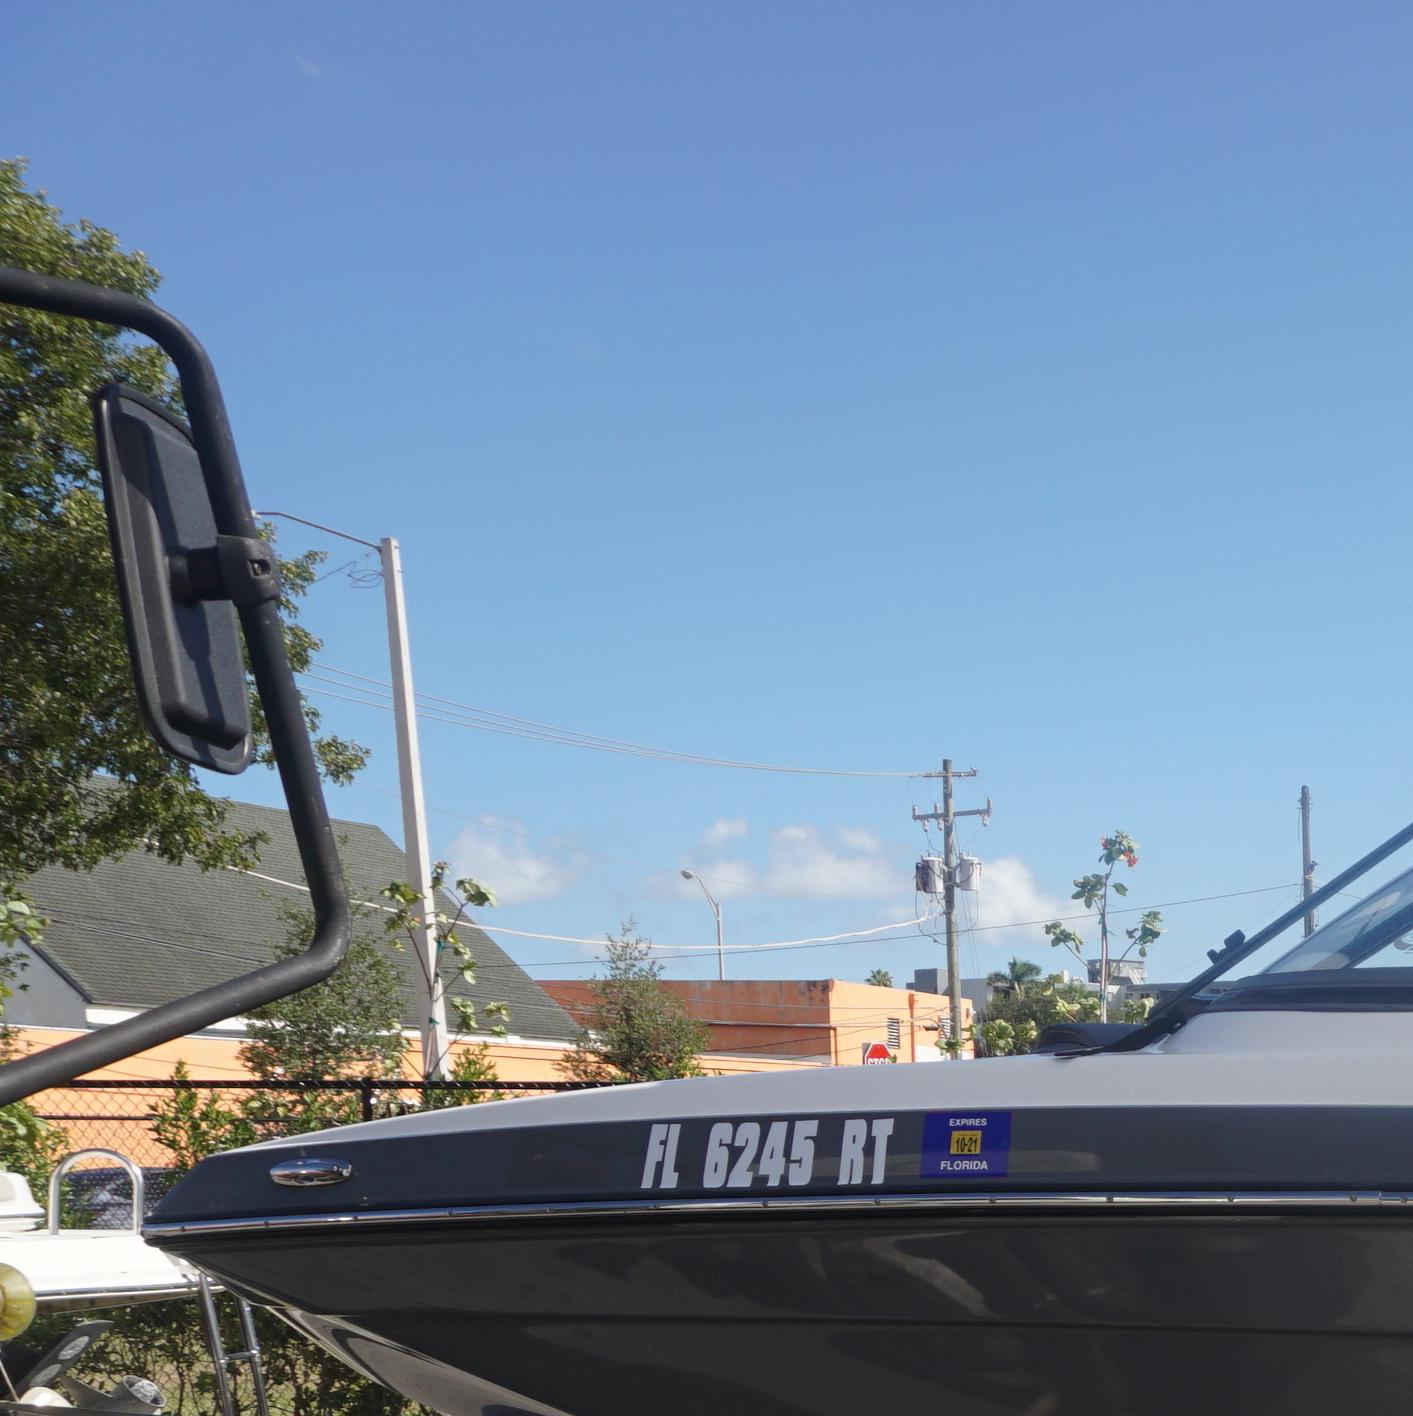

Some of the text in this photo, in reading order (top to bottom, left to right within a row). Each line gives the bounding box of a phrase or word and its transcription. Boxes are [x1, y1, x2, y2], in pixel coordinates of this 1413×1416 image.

[948, 1118, 988, 1127] EXPIRES
[955, 1136, 978, 1153] 10-21
[640, 1117, 894, 1189] FL 6245 RT
[940, 1160, 989, 1171] FLORIDA
